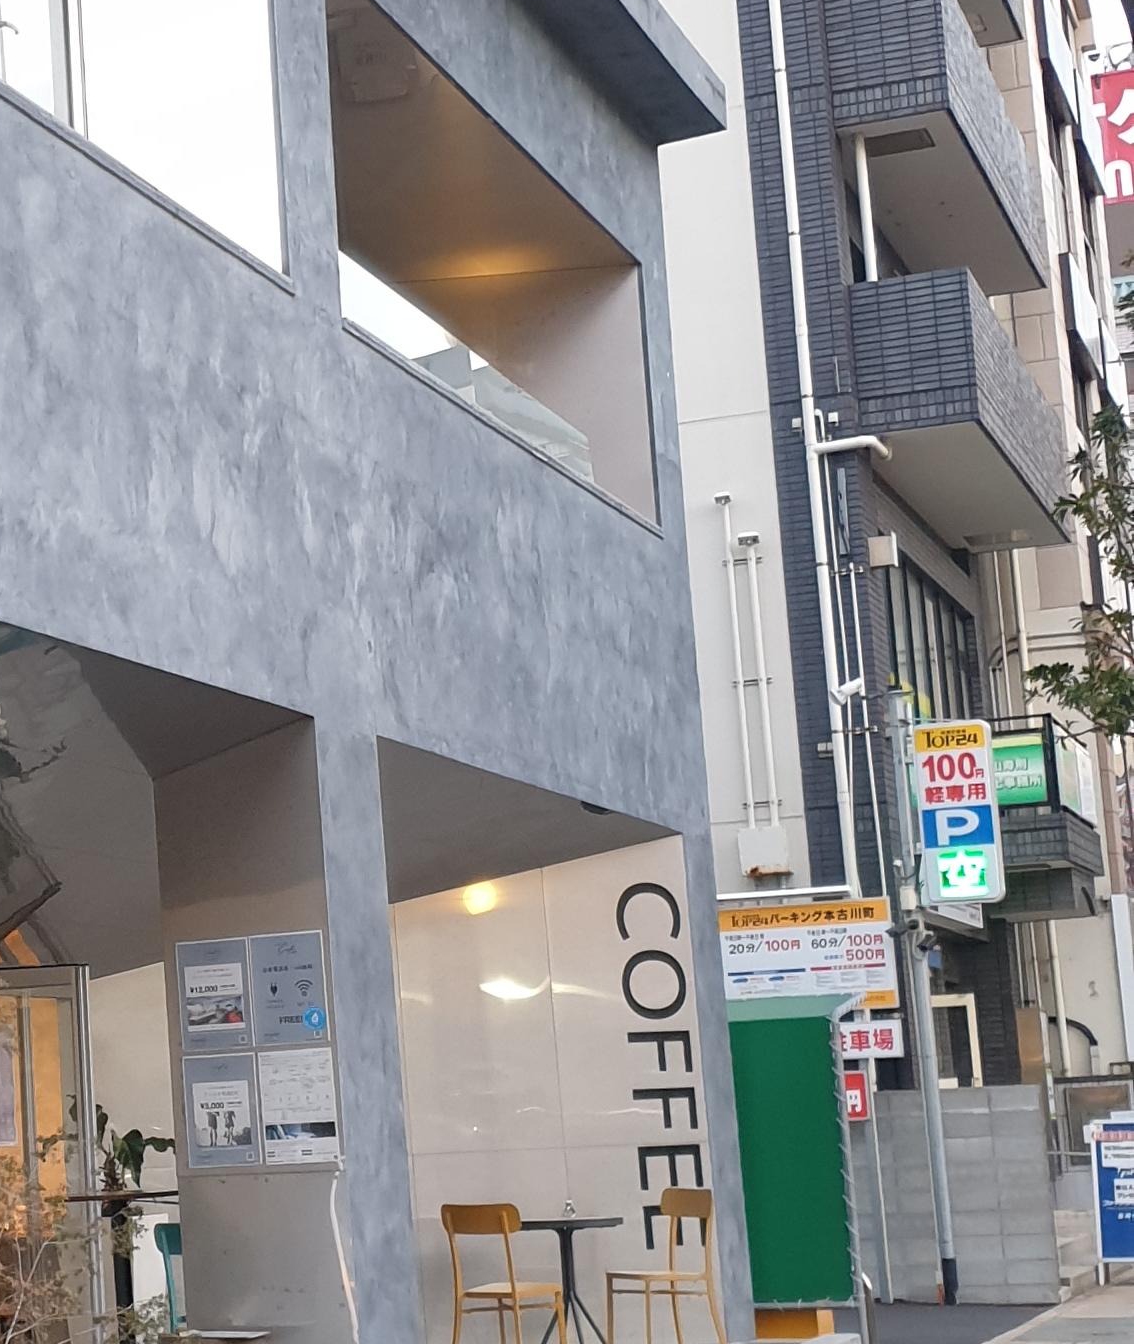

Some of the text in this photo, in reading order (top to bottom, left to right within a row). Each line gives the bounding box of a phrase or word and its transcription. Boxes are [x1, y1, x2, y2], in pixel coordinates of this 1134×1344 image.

[922, 752, 985, 783] 100円
[925, 783, 987, 804] 軽専用
[934, 809, 980, 847] P
[845, 948, 885, 961] 500円
[615, 882, 706, 1250] COFFEE
